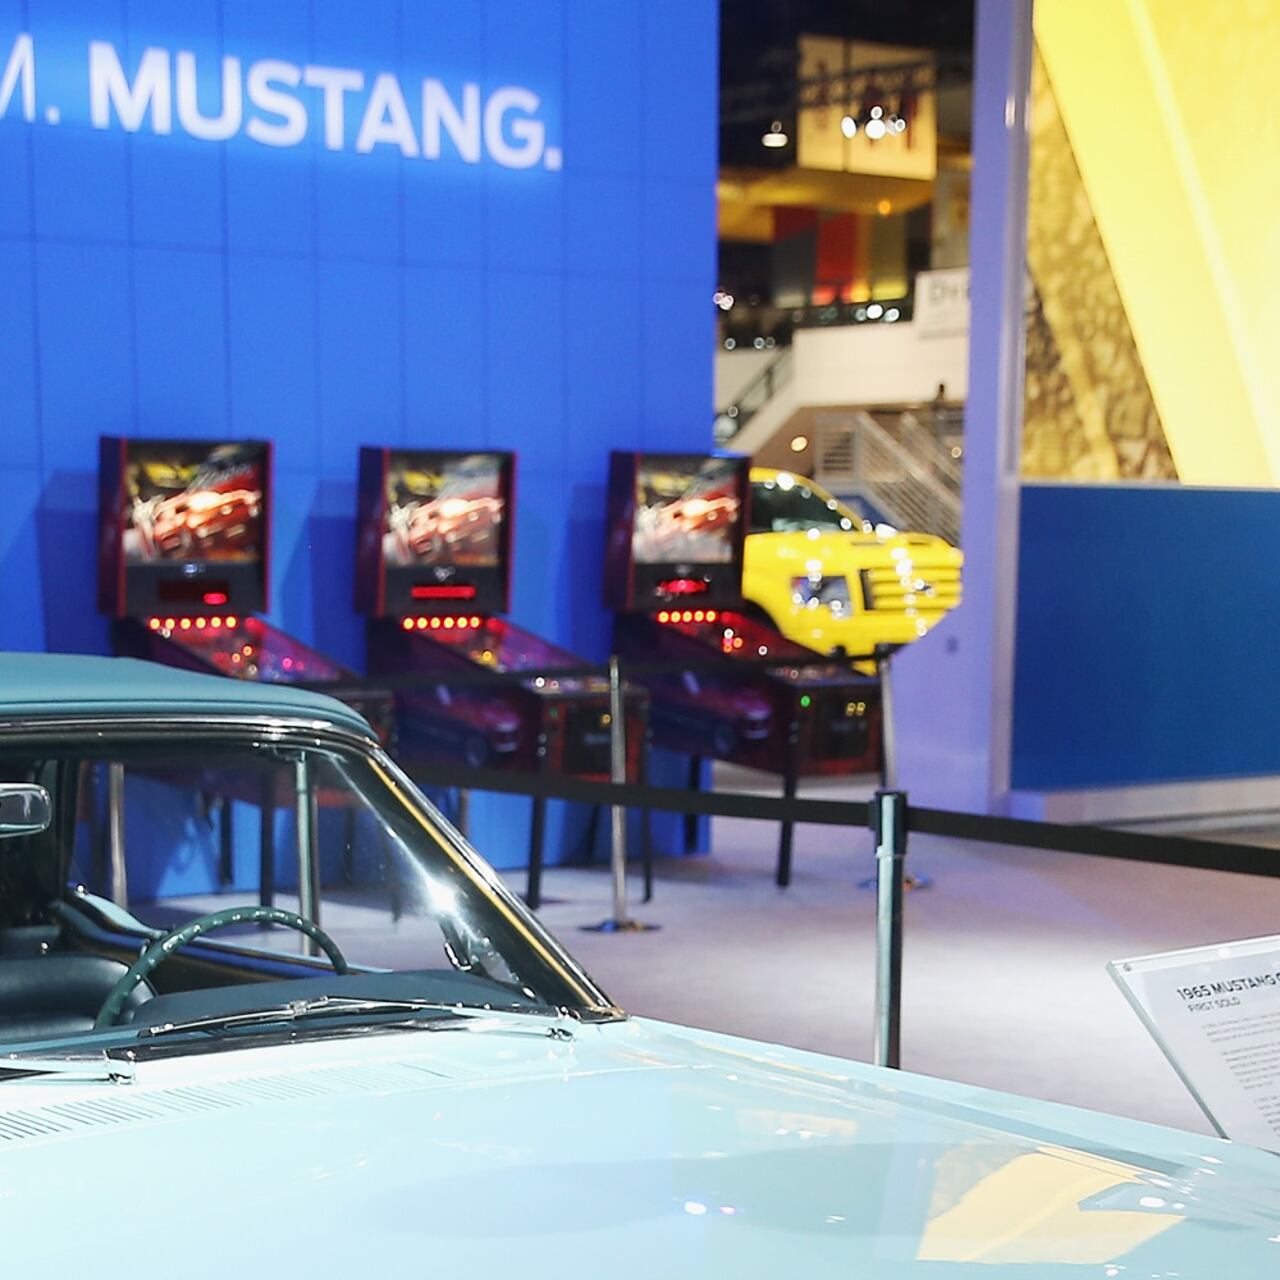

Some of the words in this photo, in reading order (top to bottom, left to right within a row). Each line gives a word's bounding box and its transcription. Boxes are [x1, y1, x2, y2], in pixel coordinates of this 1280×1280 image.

[88, 40, 563, 171] MUSTANG.
[1176, 984, 1212, 1001] 1965
[1211, 973, 1276, 995] MUSTANG
[1215, 996, 1241, 1009] SOLD
